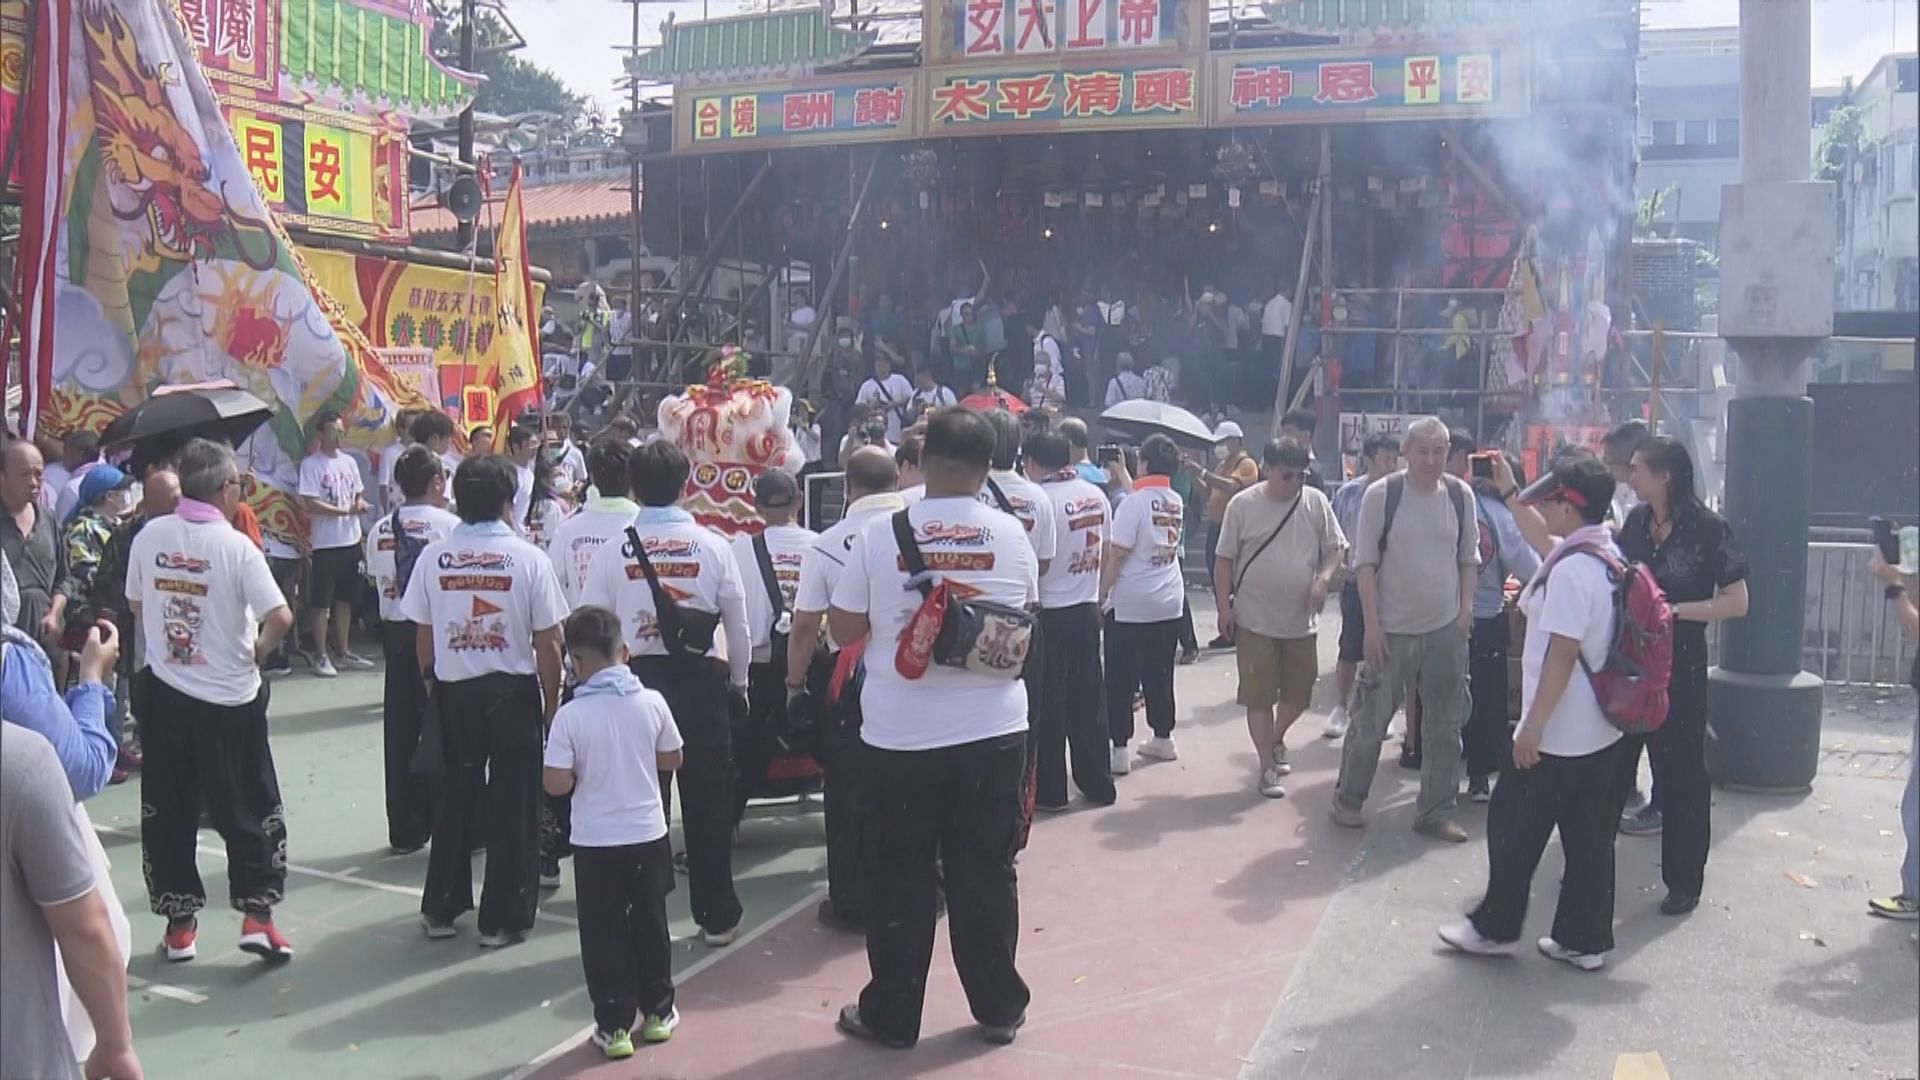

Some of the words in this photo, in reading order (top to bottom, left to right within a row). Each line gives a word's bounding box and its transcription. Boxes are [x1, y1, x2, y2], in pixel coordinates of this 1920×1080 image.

[967, 0, 1158, 53] 玄天上帝
[931, 69, 1196, 122] 太平清醮
[1229, 60, 1490, 108] 神恩平安
[245, 126, 341, 204] 民安
